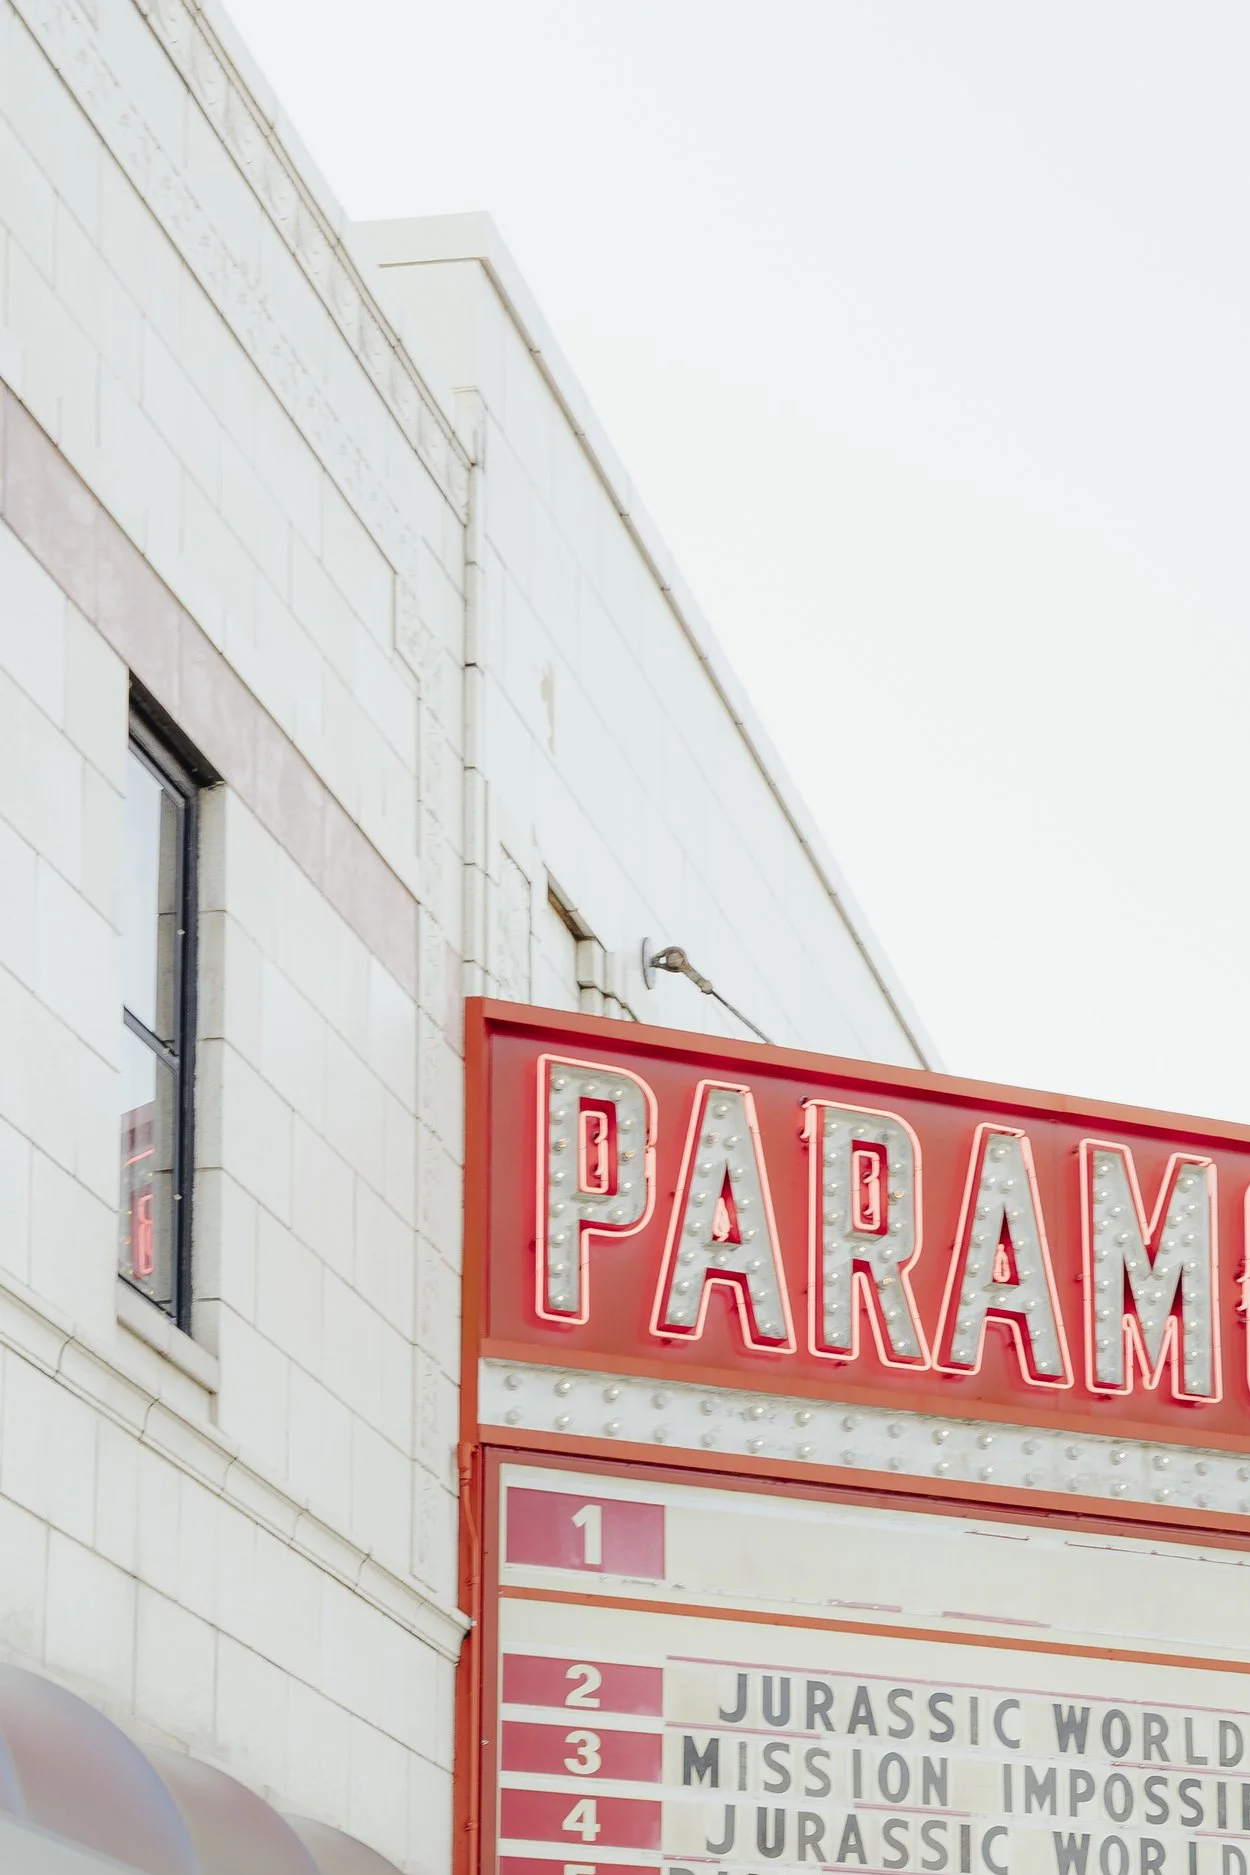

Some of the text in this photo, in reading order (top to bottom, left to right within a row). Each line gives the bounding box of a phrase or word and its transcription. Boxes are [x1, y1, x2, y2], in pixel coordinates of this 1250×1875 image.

[571, 1504, 603, 1566] 1
[564, 1663, 603, 1709] 2
[718, 1673, 1020, 1749] JURASSIC
[1052, 1702, 1244, 1768] WORLD
[563, 1730, 603, 1775] 3
[682, 1735, 949, 1807] MISSION
[561, 1798, 601, 1842] 4
[706, 1803, 1008, 1875] JURASSIC
